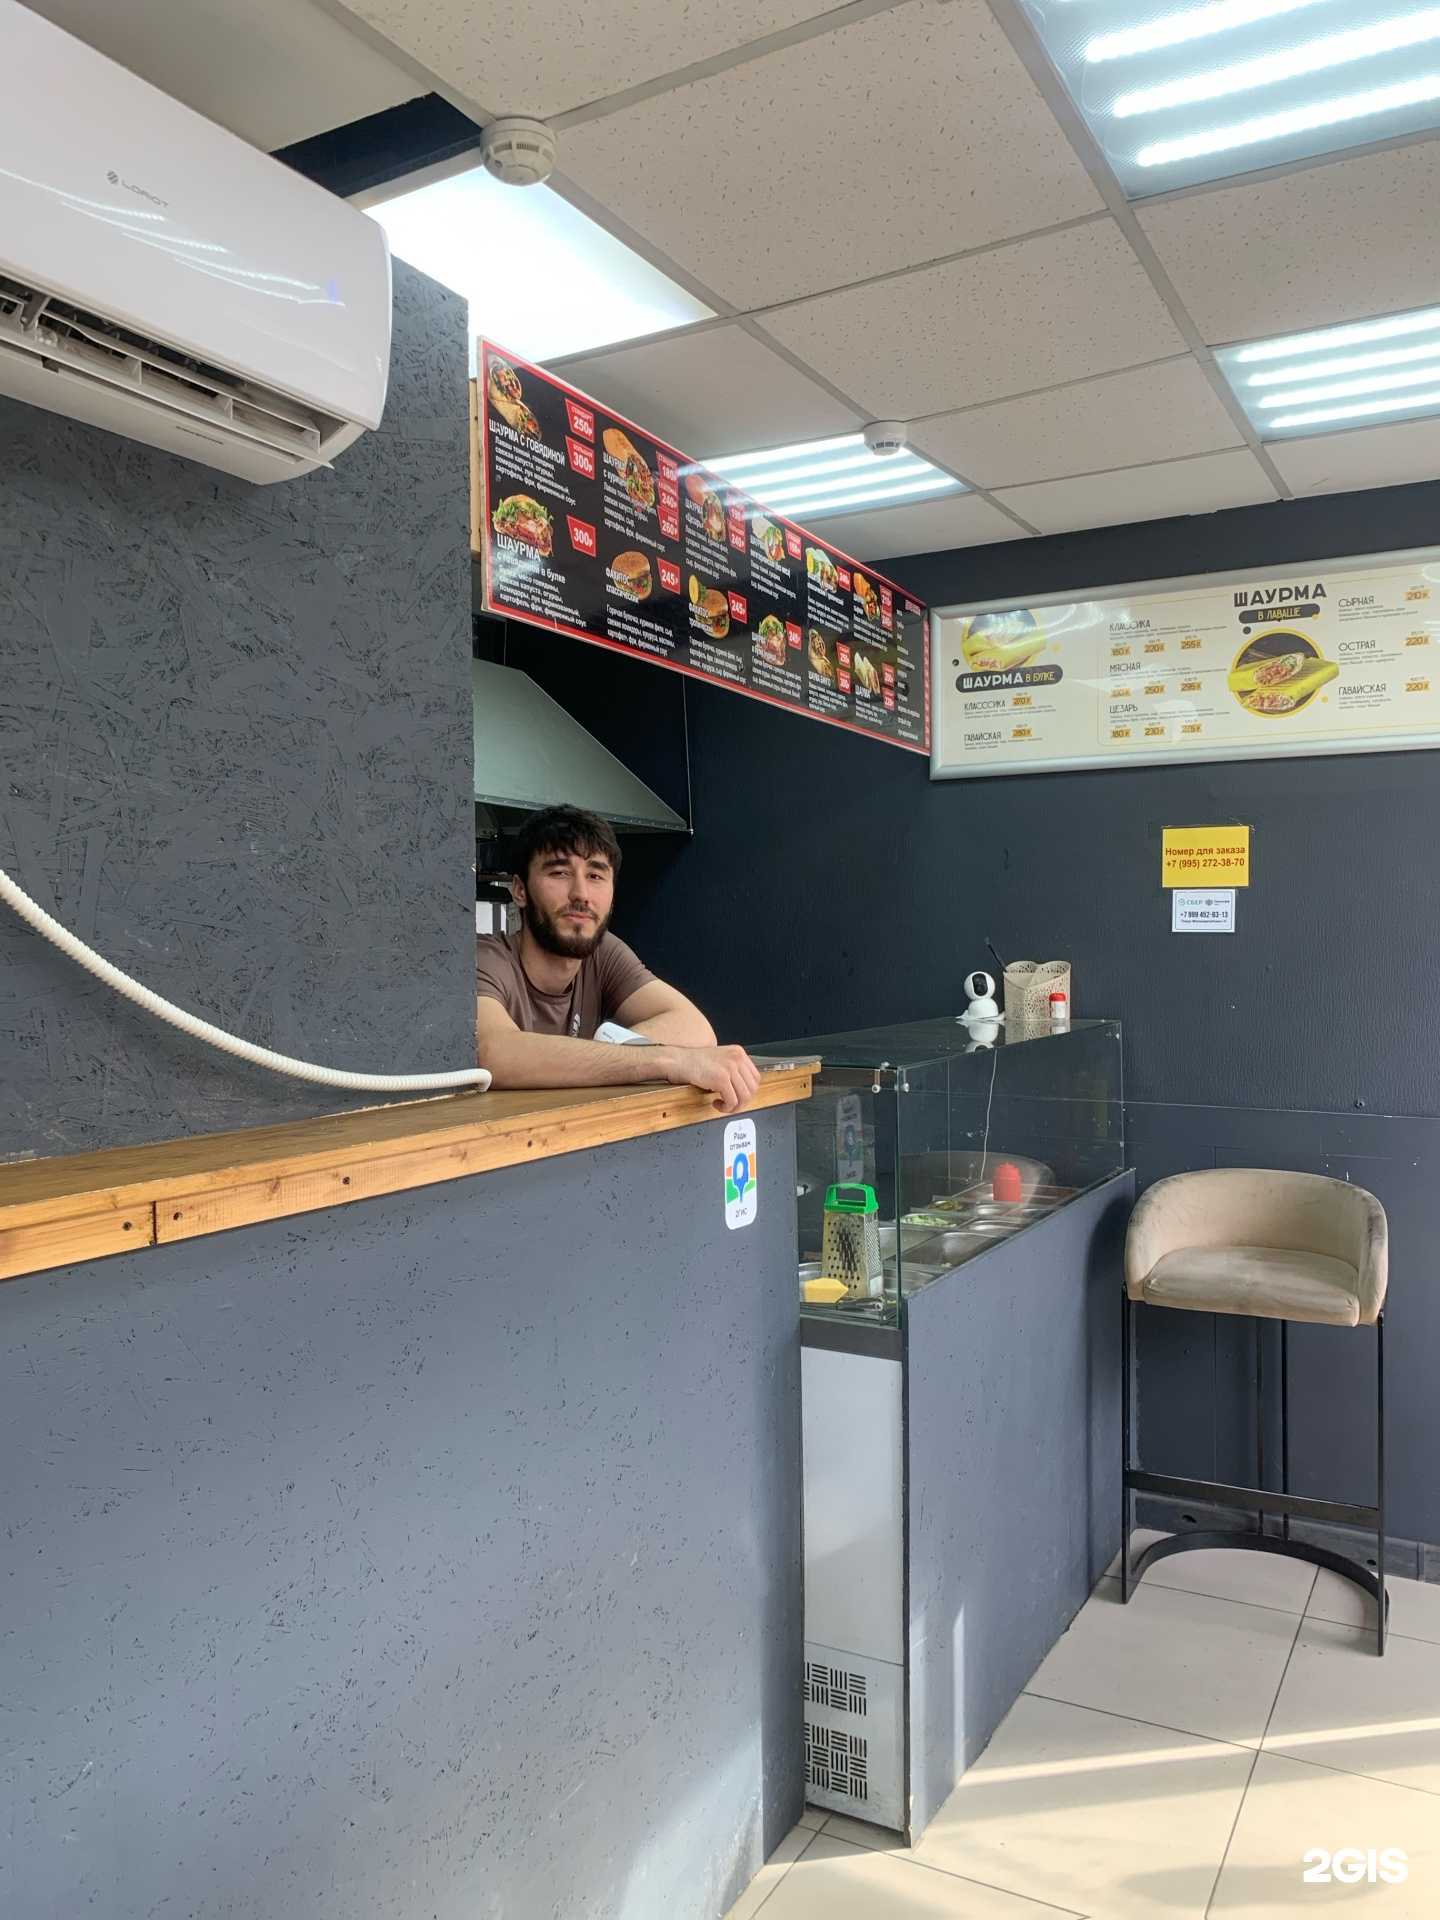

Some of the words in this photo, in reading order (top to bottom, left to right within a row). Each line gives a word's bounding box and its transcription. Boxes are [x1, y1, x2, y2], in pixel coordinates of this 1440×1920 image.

[488, 418, 519, 443] ШАУРМА
[526, 437, 565, 467] ГОВЯДИНОЙ
[573, 528, 593, 547] 300р
[496, 533, 541, 561] ШАУРМА
[547, 568, 567, 584] булке
[1233, 583, 1328, 608] ШАУРМА
[1337, 595, 1376, 608] СЫРНАЯ
[1257, 610, 1265, 621] В
[1266, 607, 1302, 620] ЛАВАШЕ
[1337, 639, 1377, 652] ОСТРАЯ
[1109, 662, 1142, 673] МЯСНАЯ
[962, 672, 1023, 690] ШАУРМА
[1025, 674, 1032, 683] В
[1032, 671, 1056, 682] БУЛКЕ
[1338, 682, 1387, 697] ГАВАЙСКАЯ
[1109, 703, 1139, 714] ЦЕЗАРЬ
[1165, 848, 1195, 858] Номер
[1195, 848, 1214, 857] для
[1215, 846, 1246, 855] заказа
[1166, 860, 1177, 868] +7
[1179, 859, 1201, 870] (995)
[1202, 857, 1245, 867] 272-38-70
